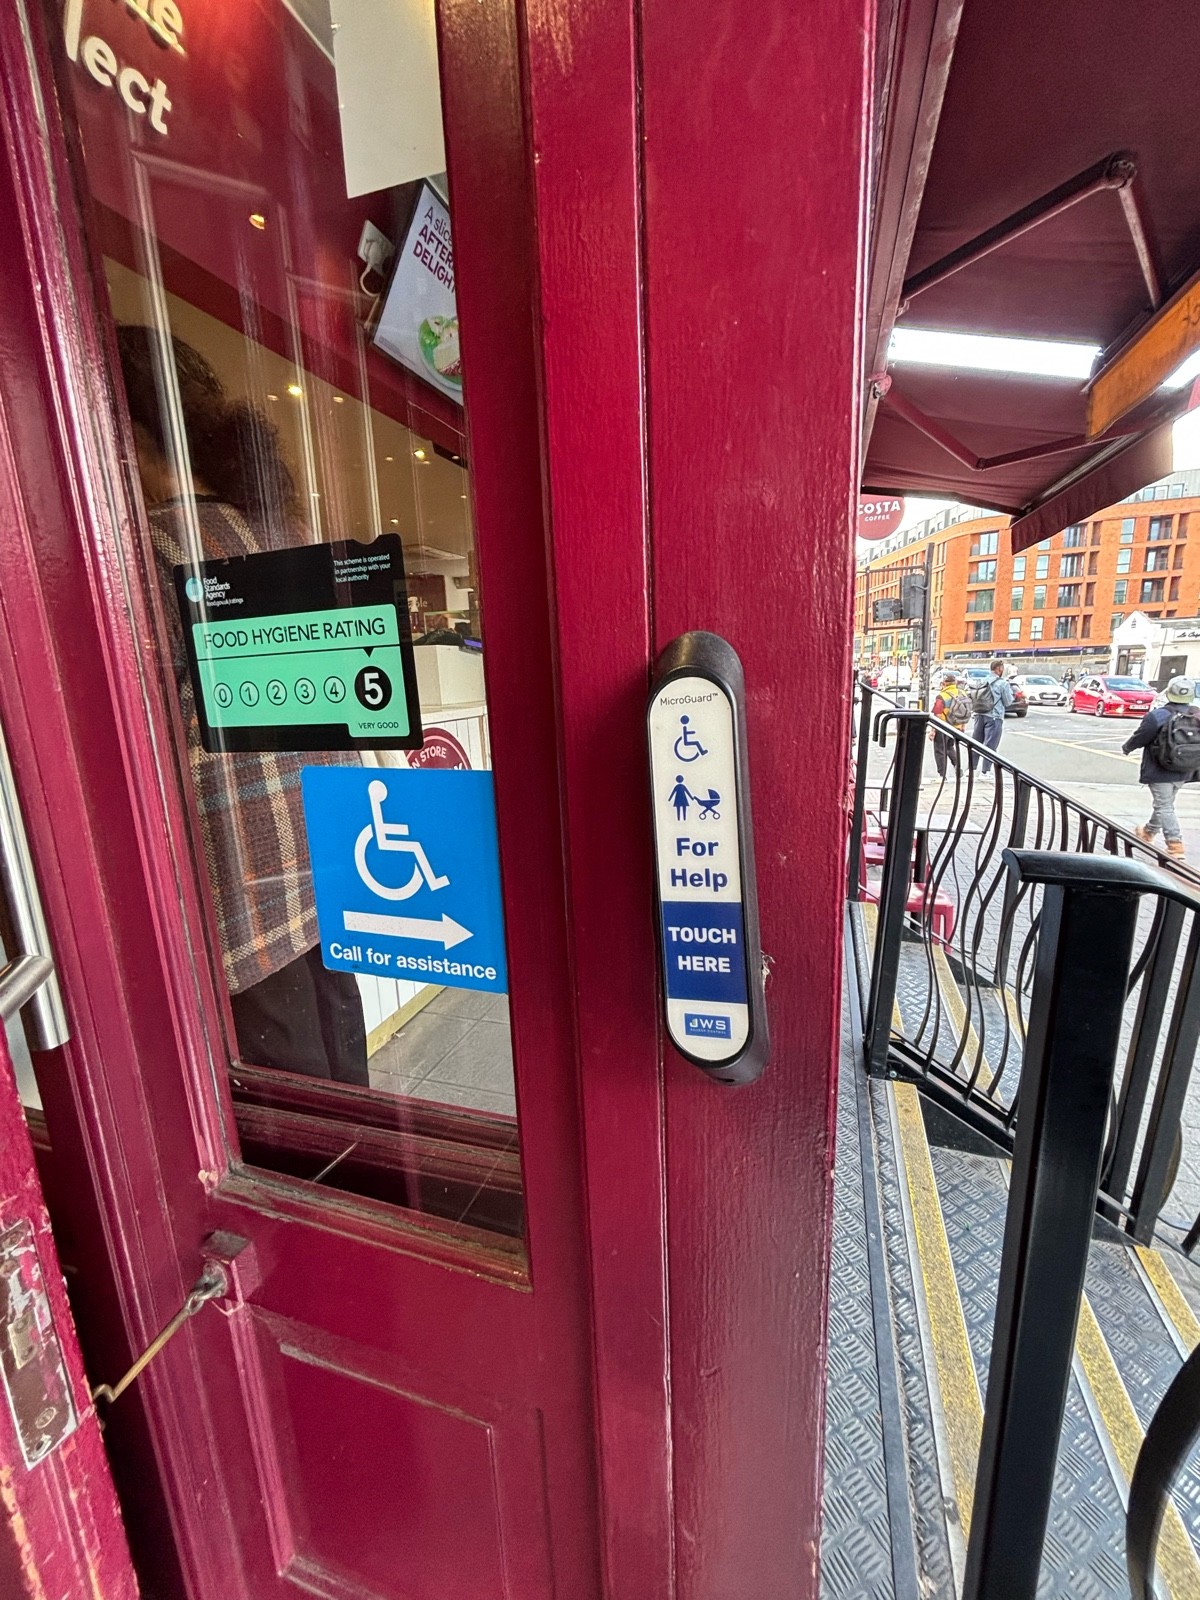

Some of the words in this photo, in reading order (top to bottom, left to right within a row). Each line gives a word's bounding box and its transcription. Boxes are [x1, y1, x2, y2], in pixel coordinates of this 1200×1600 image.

[424, 206, 434, 224] A
[865, 514, 890, 522] COFFEE
[367, 553, 390, 563] operated
[340, 565, 367, 575] partnership
[367, 563, 379, 571] with
[379, 562, 391, 571] your
[203, 576, 218, 585] Food
[335, 575, 347, 583] local
[347, 573, 370, 582] authority
[204, 582, 231, 592] Standards
[205, 591, 226, 600] Agency
[204, 630, 248, 649] FOOD
[252, 624, 321, 645] HYGIENE
[324, 617, 386, 639] RATING
[219, 687, 228, 703] 0
[272, 684, 282, 700] 2
[300, 681, 310, 698] 3
[329, 680, 339, 698] 4
[364, 672, 384, 706] 5
[358, 722, 375, 730] VERY
[377, 721, 399, 729] GOOD
[420, 746, 447, 762] STORE
[676, 837, 719, 857] For
[670, 868, 728, 892] Help
[668, 926, 737, 944] TOUCH
[329, 942, 363, 962] Call
[366, 948, 391, 966] for
[396, 956, 497, 980] assistance
[677, 955, 731, 973] HERE
[689, 1018, 727, 1030] JWS
